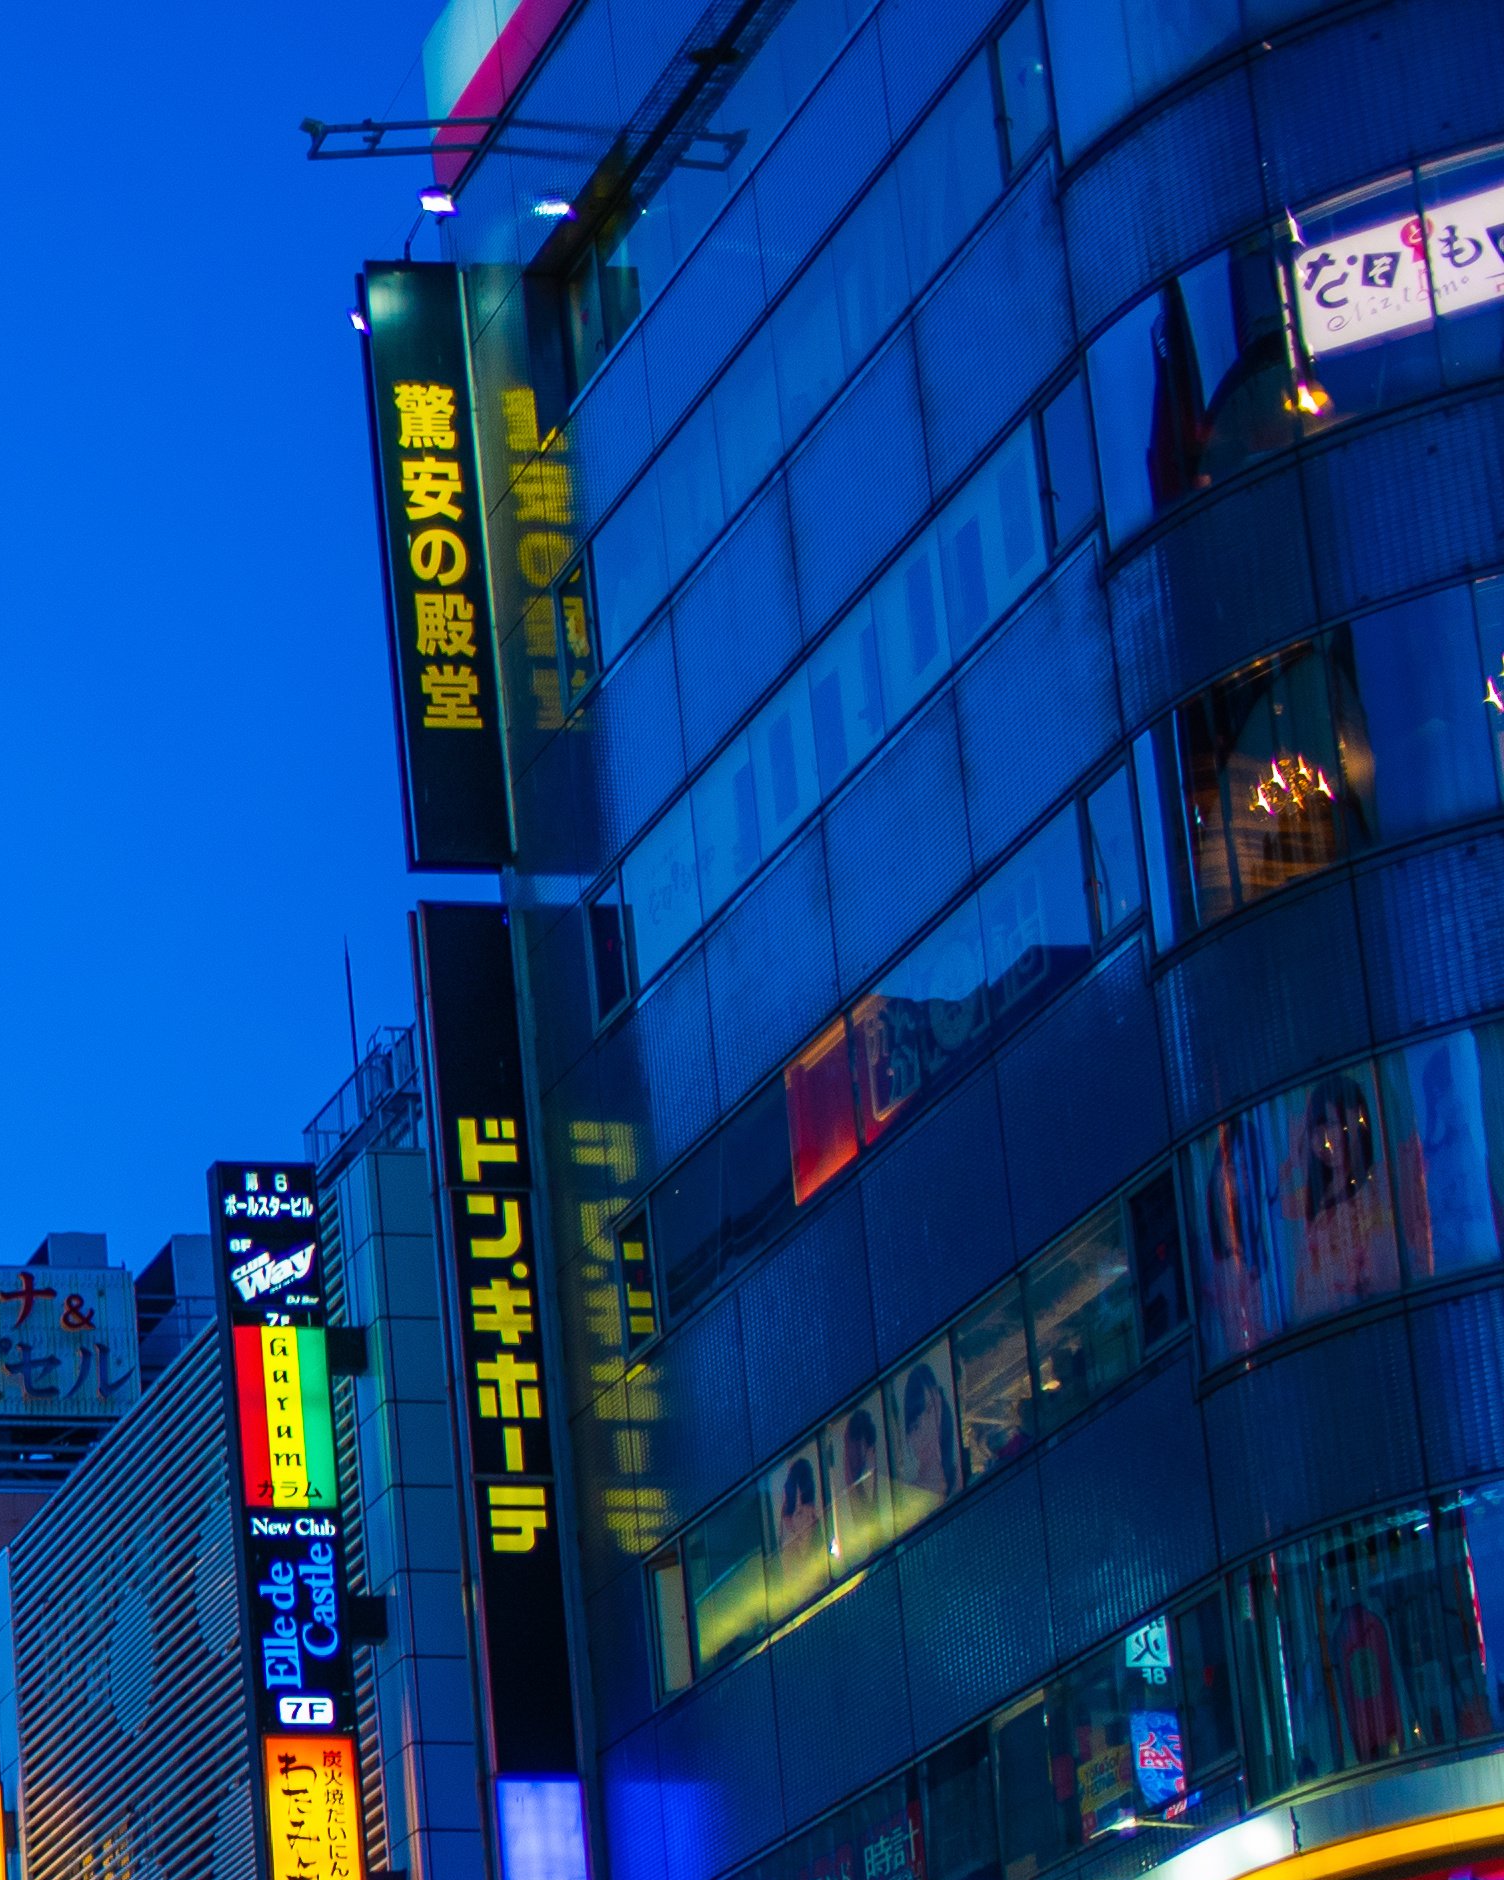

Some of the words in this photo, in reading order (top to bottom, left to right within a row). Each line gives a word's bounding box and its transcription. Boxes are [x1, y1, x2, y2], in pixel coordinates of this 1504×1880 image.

[394, 381, 483, 730] 驚安の殿堂
[457, 1117, 548, 1555] ドン・キホーテ
[256, 1479, 323, 1501] ガラム
[251, 1517, 291, 1536] New
[295, 1517, 336, 1537] Club
[300, 1542, 338, 1658] Castle
[286, 1701, 328, 1721] 7F
